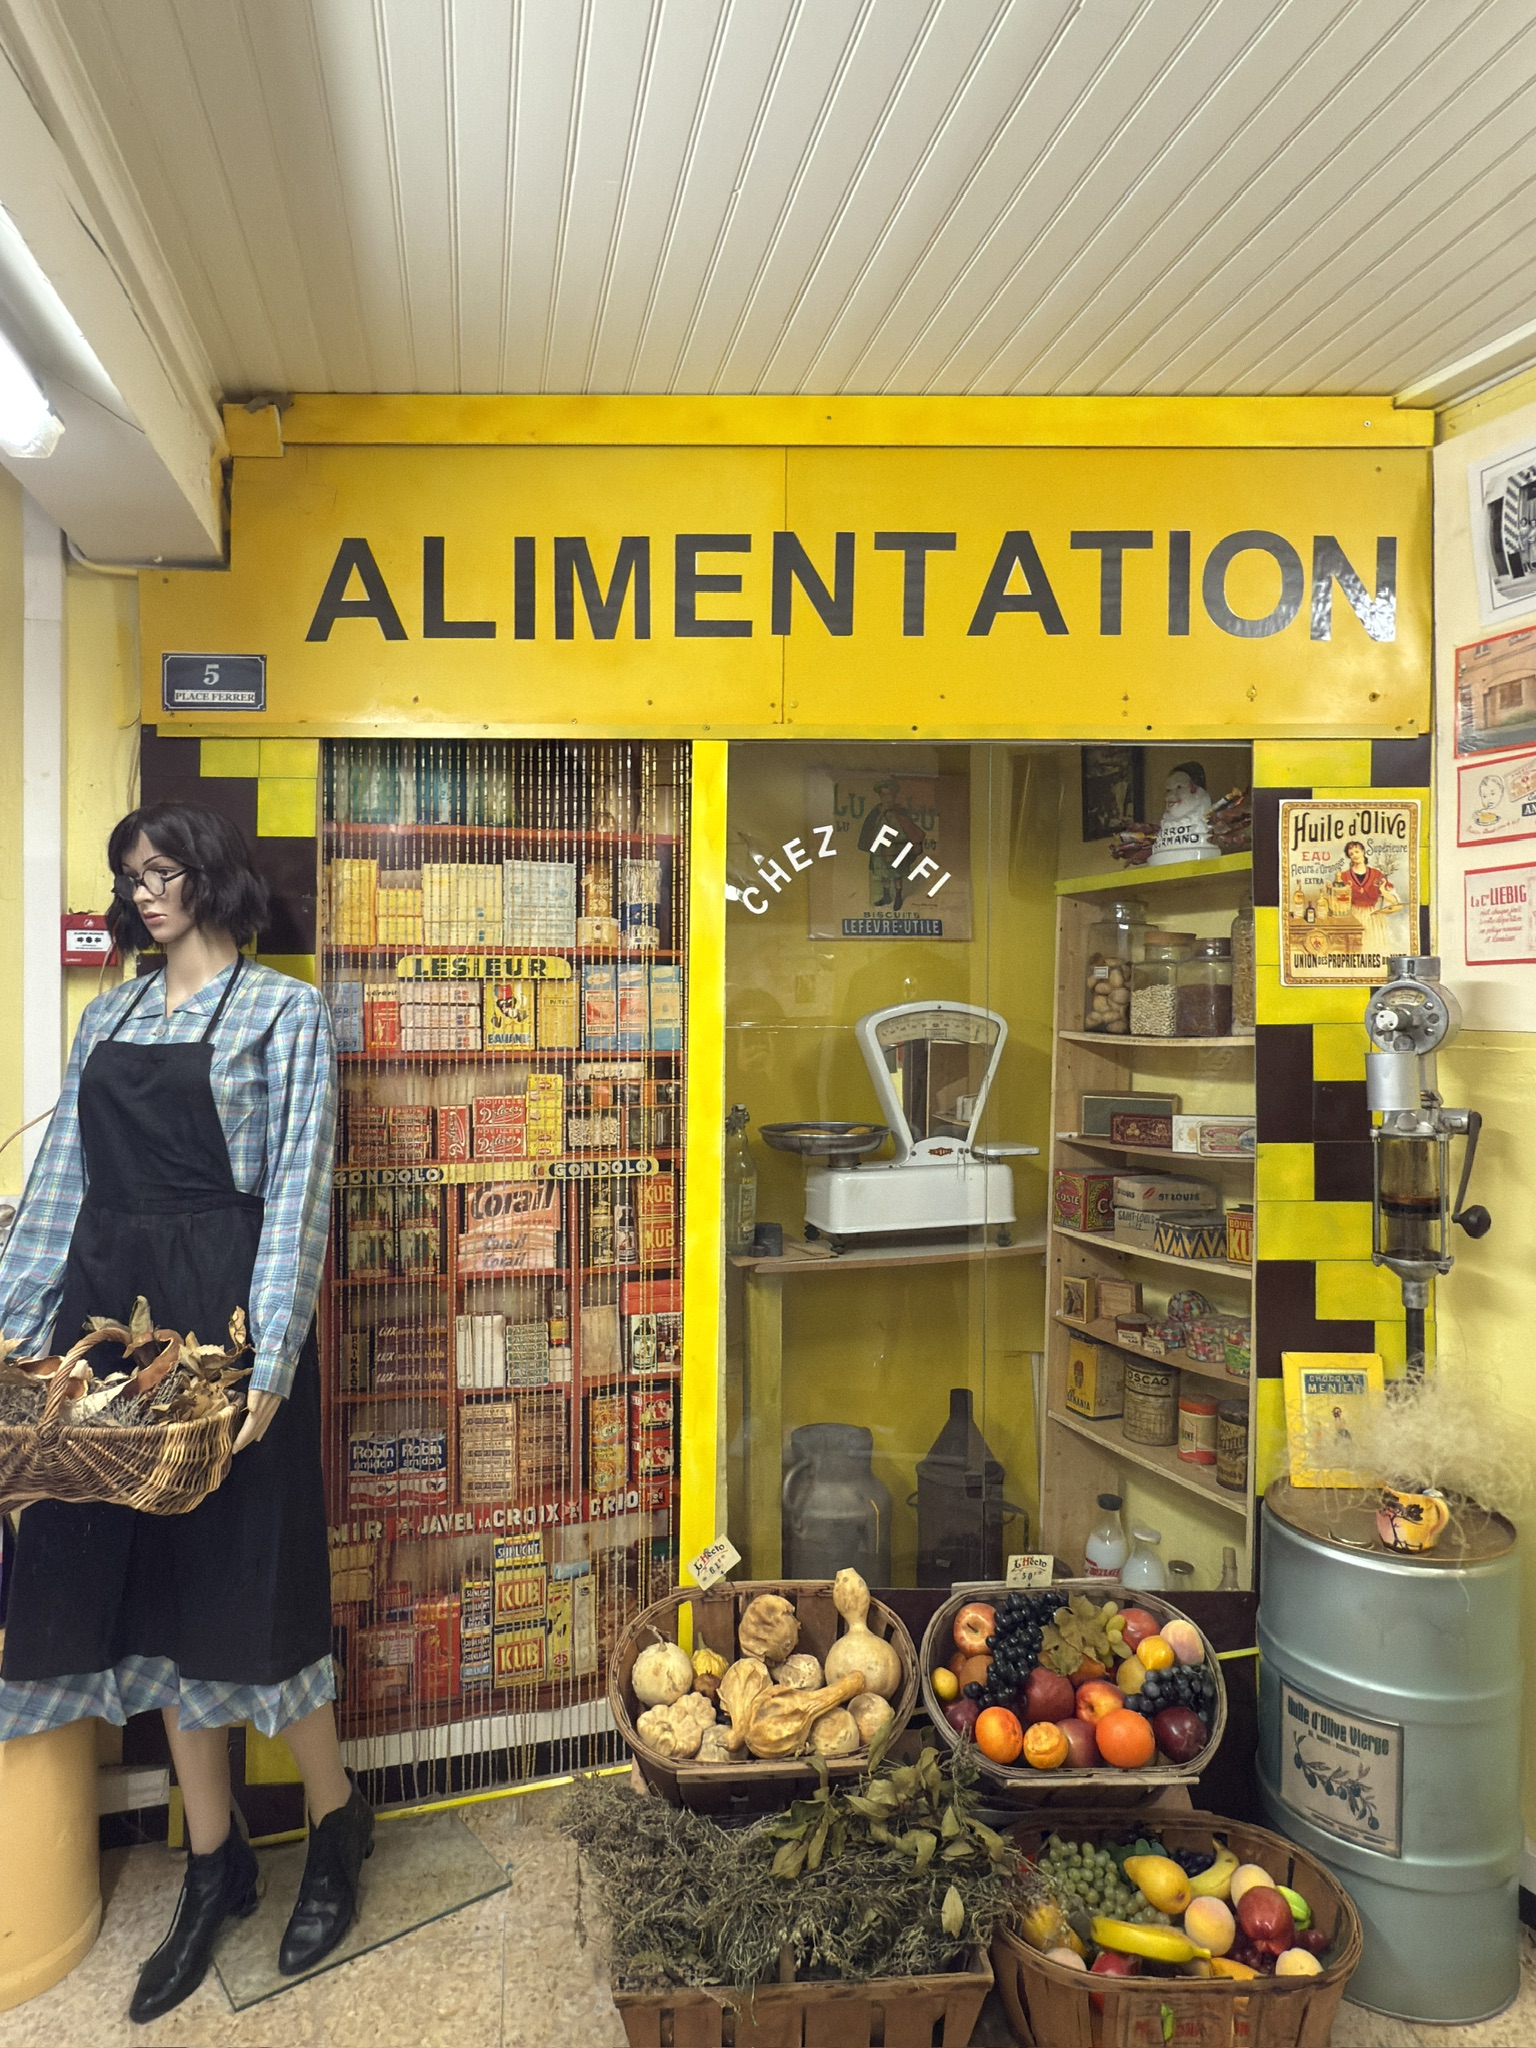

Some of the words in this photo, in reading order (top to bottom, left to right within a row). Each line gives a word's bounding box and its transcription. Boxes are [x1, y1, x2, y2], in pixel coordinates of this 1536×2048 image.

[305, 530, 1398, 643] ALIMENTATION
[203, 663, 220, 685] 5
[175, 692, 209, 701] PLACE
[211, 693, 255, 702] FERRER
[1291, 812, 1344, 852] Huile
[1348, 810, 1406, 840] d'Olive
[1302, 851, 1331, 862] EAU
[742, 825, 837, 915] CHEZ
[869, 824, 951, 898] FIFI
[1304, 877, 1325, 885] EXTRA
[1490, 885, 1527, 906] LIEBIG
[863, 911, 920, 919] BISCUITS
[844, 919, 940, 934] LEFEVRE-UTILE
[415, 957, 548, 978] LESIEUR
[1293, 953, 1318, 968] UNION
[1327, 953, 1381, 968] PROPRIETAIRES
[335, 1168, 441, 1185] GONDOLO
[554, 1160, 648, 1176] GONDOLO
[470, 1181, 556, 1221] Corail
[644, 1185, 674, 1203] KUB
[1056, 1192, 1080, 1205] COSTE
[645, 1229, 674, 1248] KUB
[353, 1444, 394, 1460] Robin
[401, 1442, 442, 1457] Robin
[354, 1460, 394, 1469] amidon
[418, 1512, 476, 1535] JAVEL
[493, 1502, 561, 1529] CROIX
[497, 1542, 540, 1559] SUNLIGHT
[501, 1580, 540, 1609] KUB
[501, 1643, 539, 1670] KUB
[1311, 1711, 1347, 1743] d'Olive
[1349, 1725, 1390, 1756] Vierge
